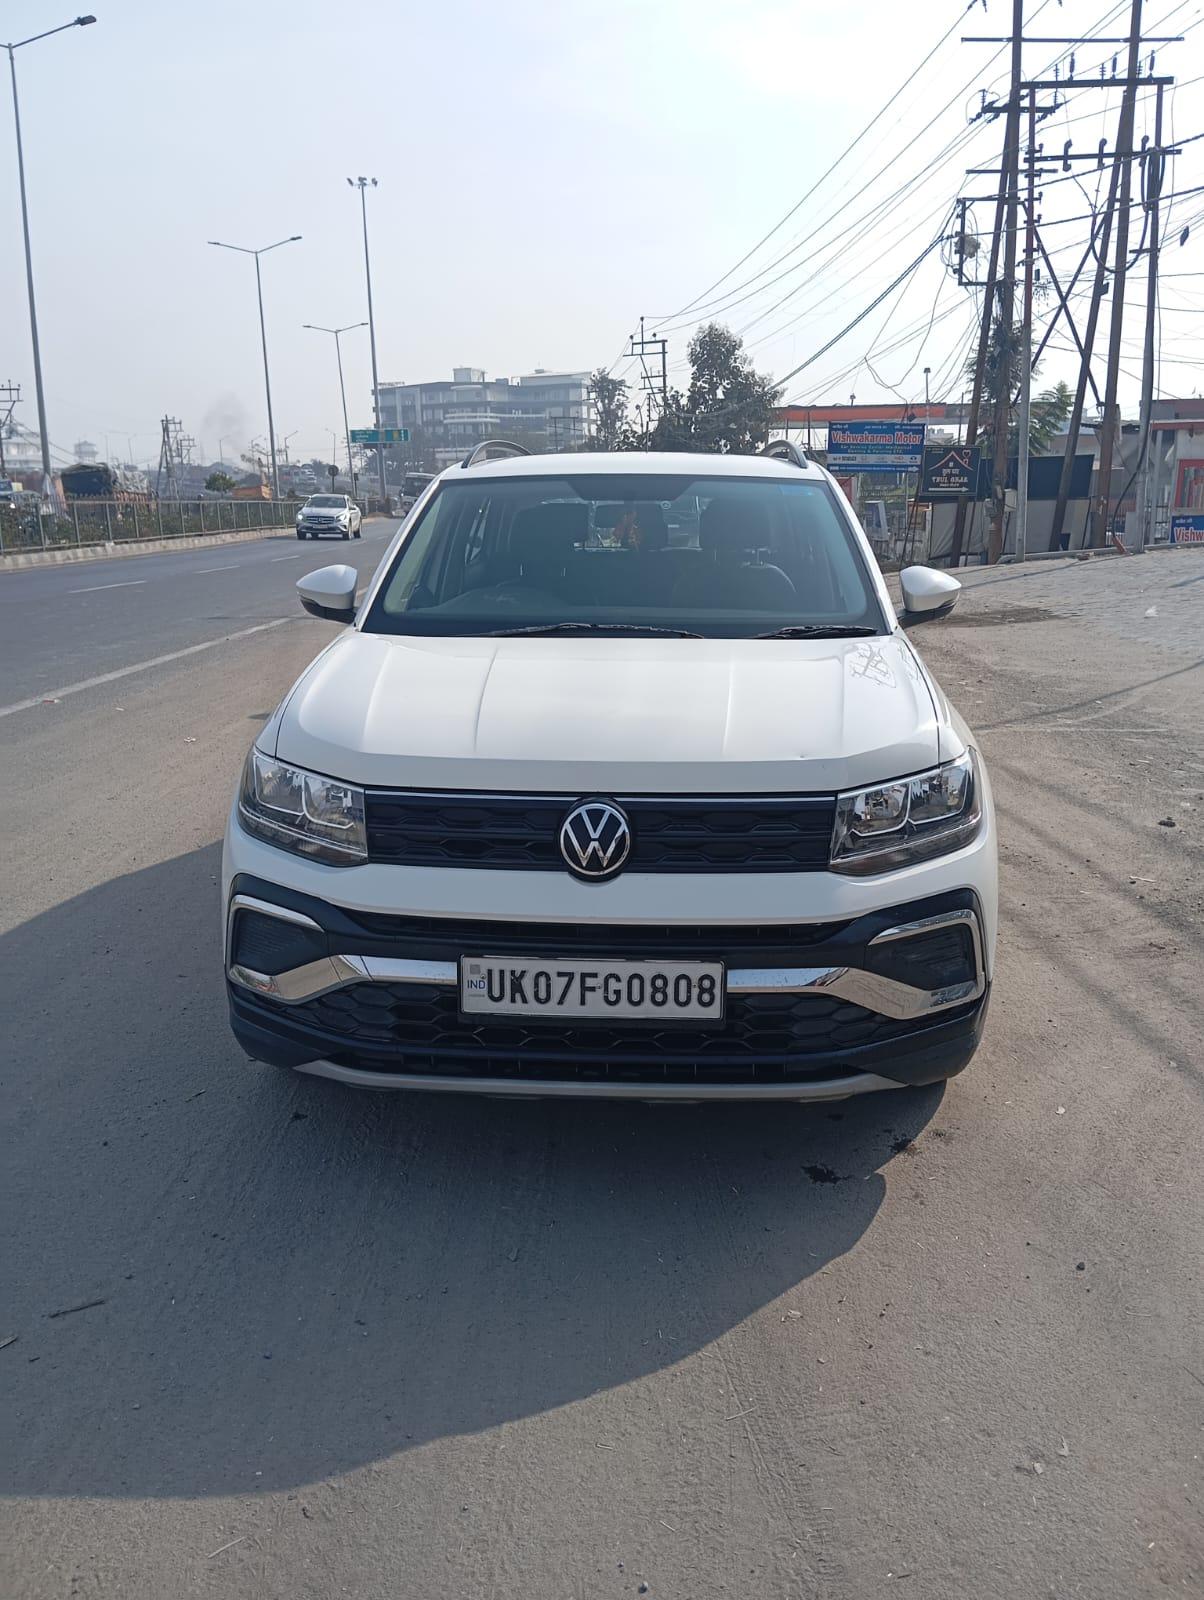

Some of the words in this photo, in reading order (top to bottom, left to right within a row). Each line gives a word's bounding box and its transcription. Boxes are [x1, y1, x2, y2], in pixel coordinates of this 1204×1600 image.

[831, 430, 893, 444] Vishwakarma
[894, 431, 922, 445] Motor
[467, 979, 486, 990] IND
[486, 967, 716, 1008] UK07FG0808
